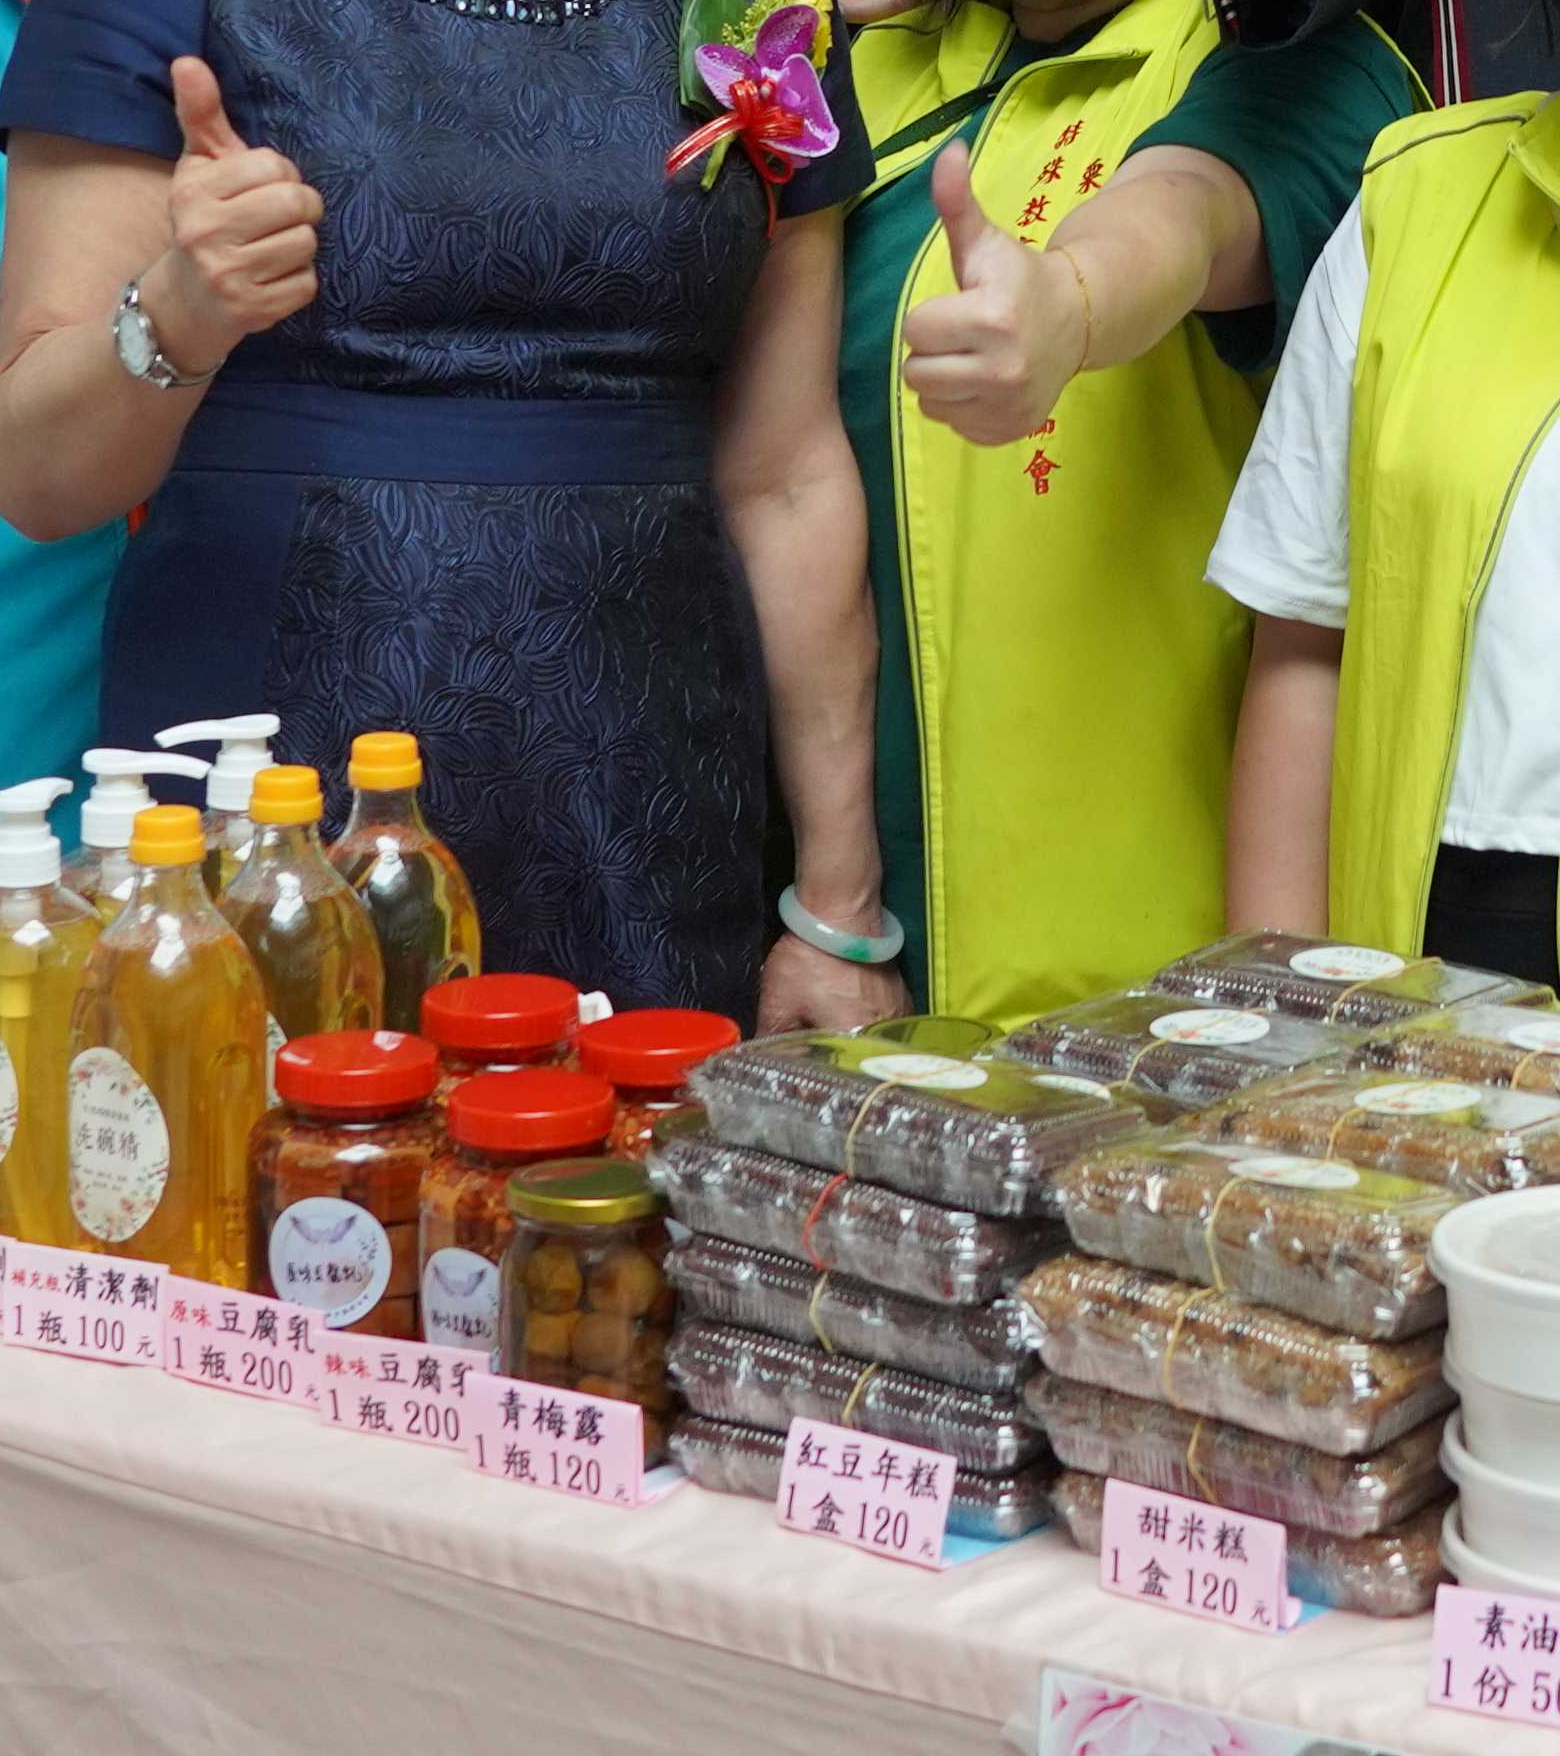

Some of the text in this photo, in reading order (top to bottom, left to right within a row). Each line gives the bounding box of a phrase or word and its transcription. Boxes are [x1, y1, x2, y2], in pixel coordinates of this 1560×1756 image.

[498, 1387, 606, 1446] 青梅露
[797, 1430, 941, 1502] 紅豆年糕
[1138, 1505, 1249, 1564] 甜米糕
